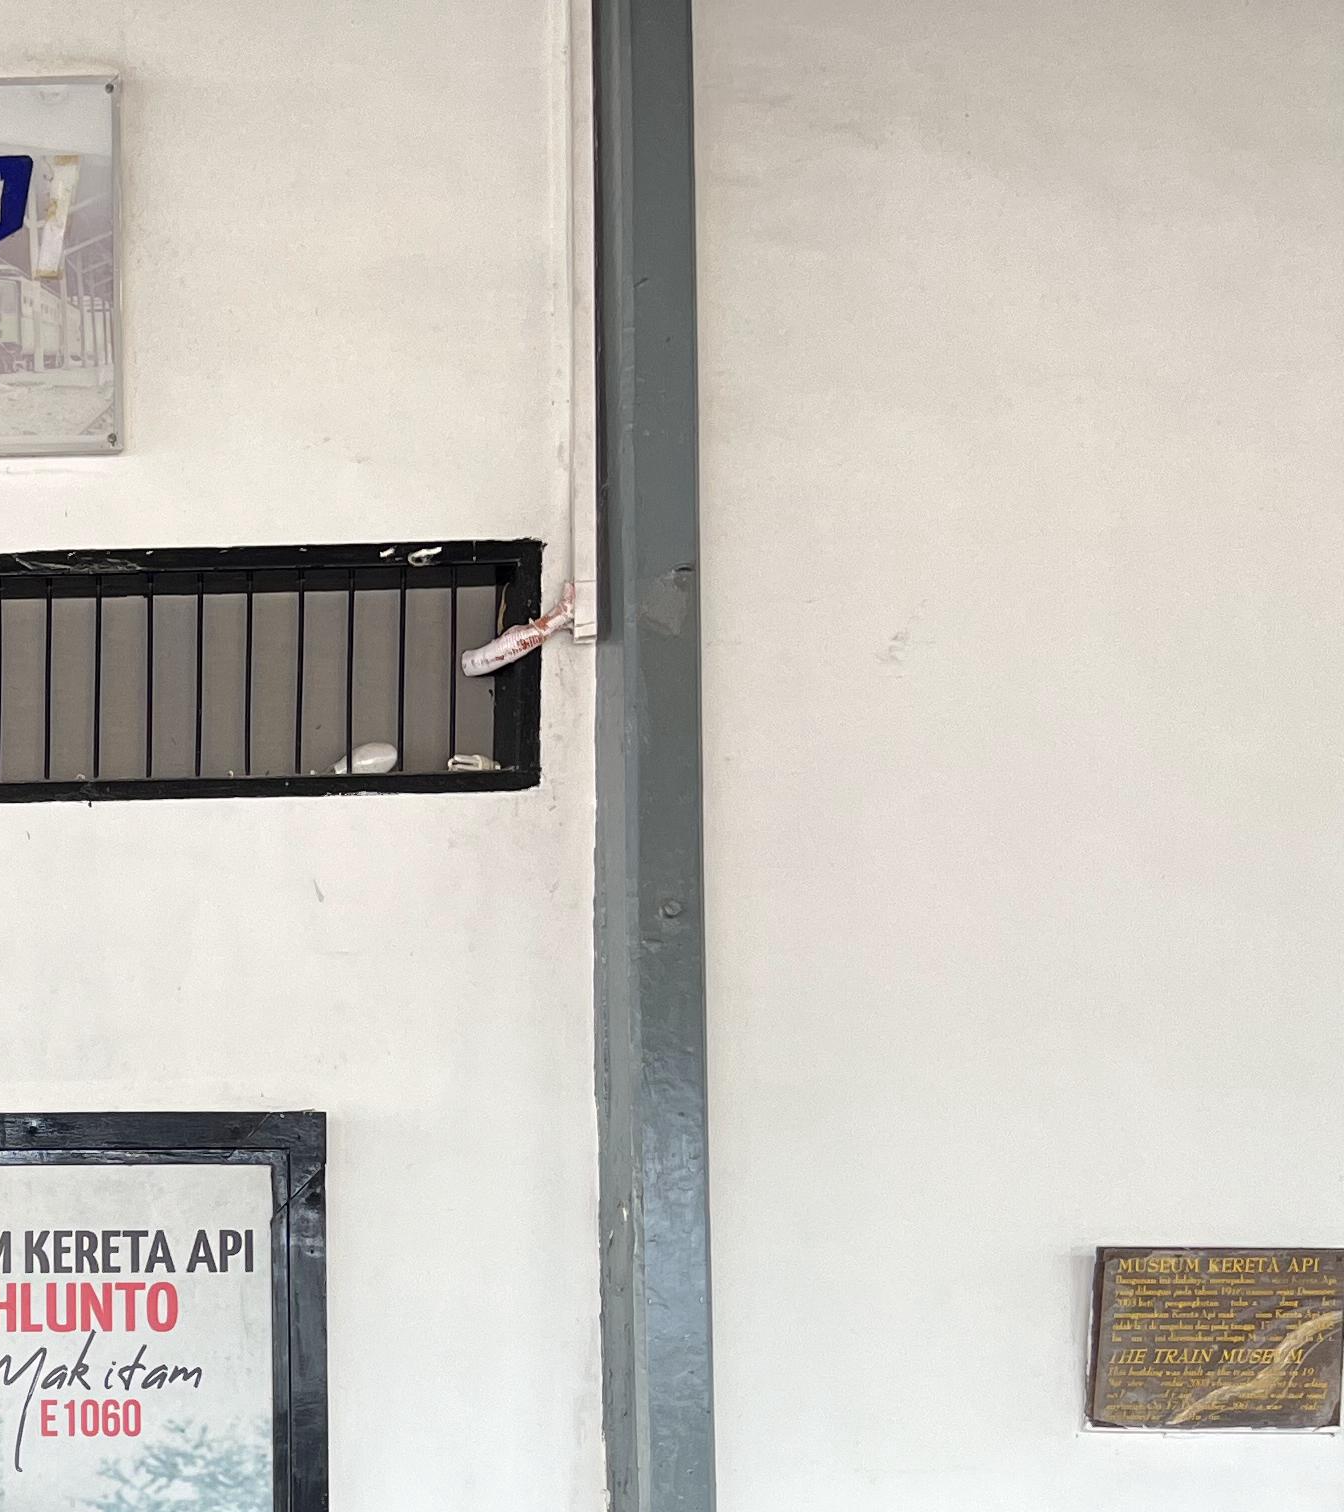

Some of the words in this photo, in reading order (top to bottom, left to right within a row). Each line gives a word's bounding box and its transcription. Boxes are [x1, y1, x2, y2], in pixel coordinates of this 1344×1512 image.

[24, 1229, 174, 1274] KERETA
[187, 1229, 255, 1274] API
[1117, 1257, 1200, 1273] MUSEUM
[1208, 1257, 1279, 1273] KERETA
[1287, 1257, 1321, 1273] API
[103, 1343, 202, 1391] itam
[1109, 1349, 1148, 1364] THE
[1153, 1348, 1214, 1364] TRAIN
[1218, 1349, 1305, 1364] MUSEM
[40, 1398, 142, 1438] E1060
